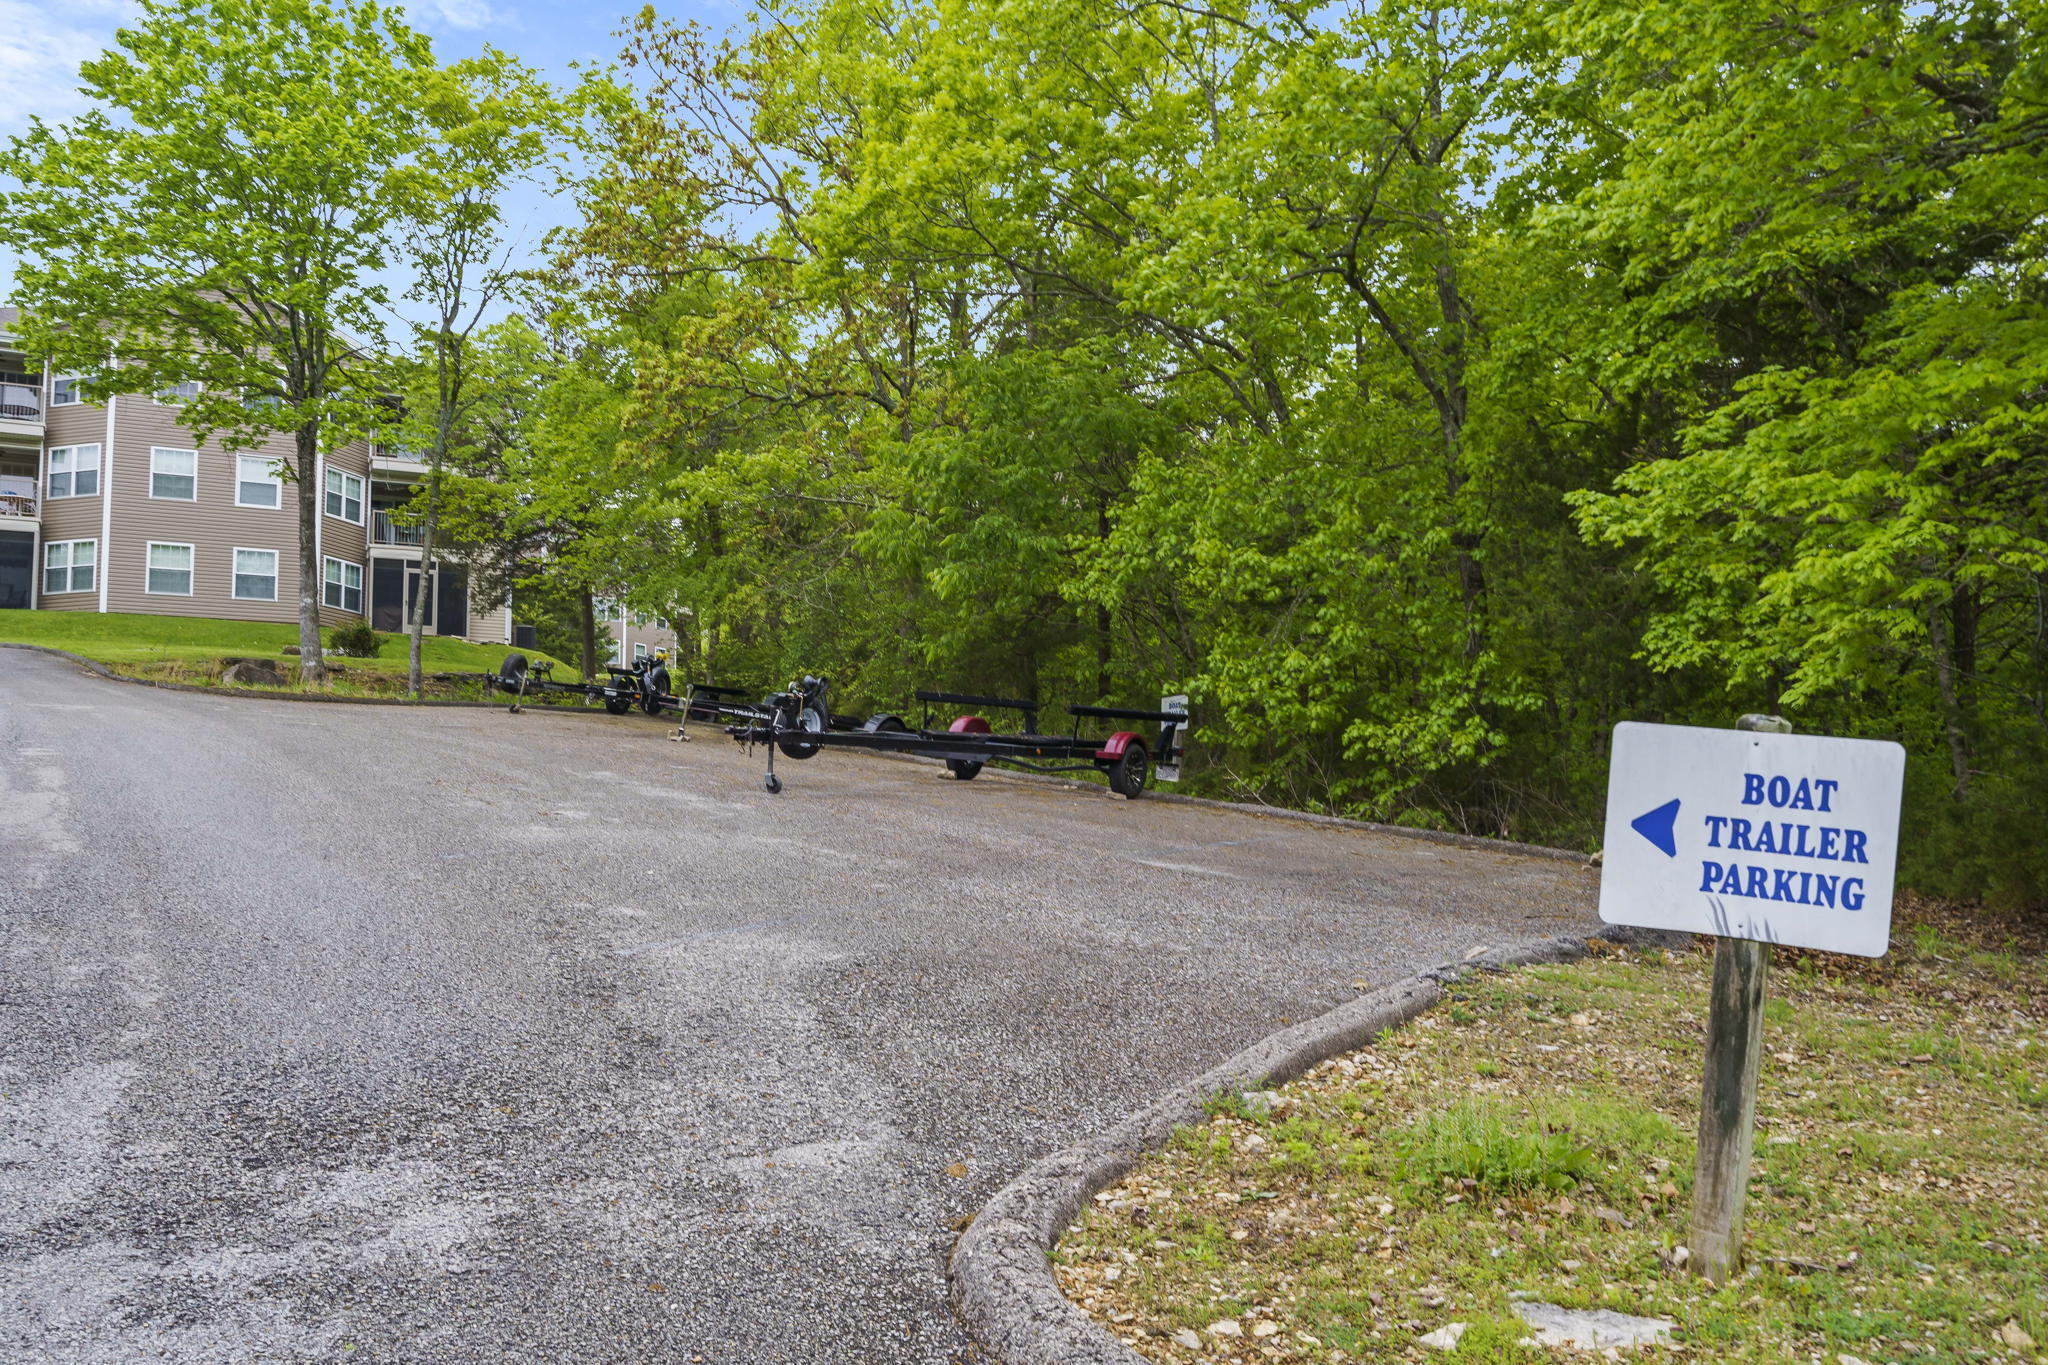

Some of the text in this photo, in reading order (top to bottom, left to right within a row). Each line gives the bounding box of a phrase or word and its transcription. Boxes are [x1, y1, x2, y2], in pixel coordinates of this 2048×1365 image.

[1742, 773, 1838, 812] BOAT
[1705, 815, 1868, 864] TRAILER
[1700, 861, 1865, 910] PARKING
